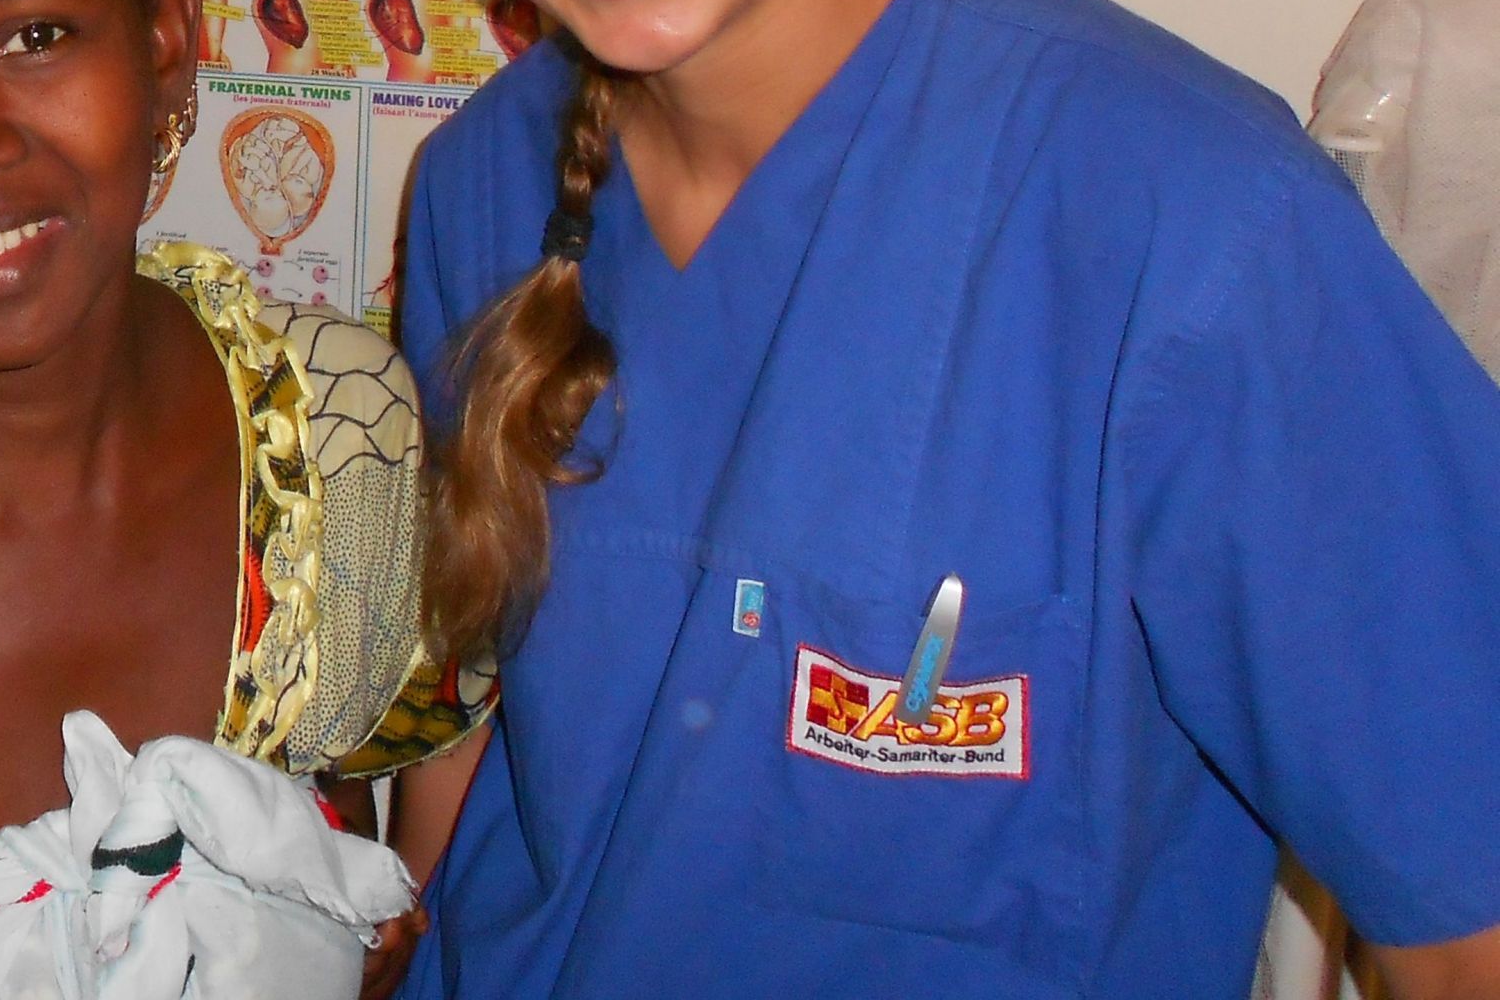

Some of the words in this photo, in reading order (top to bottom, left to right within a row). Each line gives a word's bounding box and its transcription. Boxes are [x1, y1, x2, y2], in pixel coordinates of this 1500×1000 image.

[321, 69, 346, 77] Weeks
[209, 81, 296, 98] FRATERNAL
[301, 86, 352, 101] TWINS
[372, 92, 425, 107] MAKING
[428, 96, 459, 110] LOVE
[851, 691, 1010, 747] ASB
